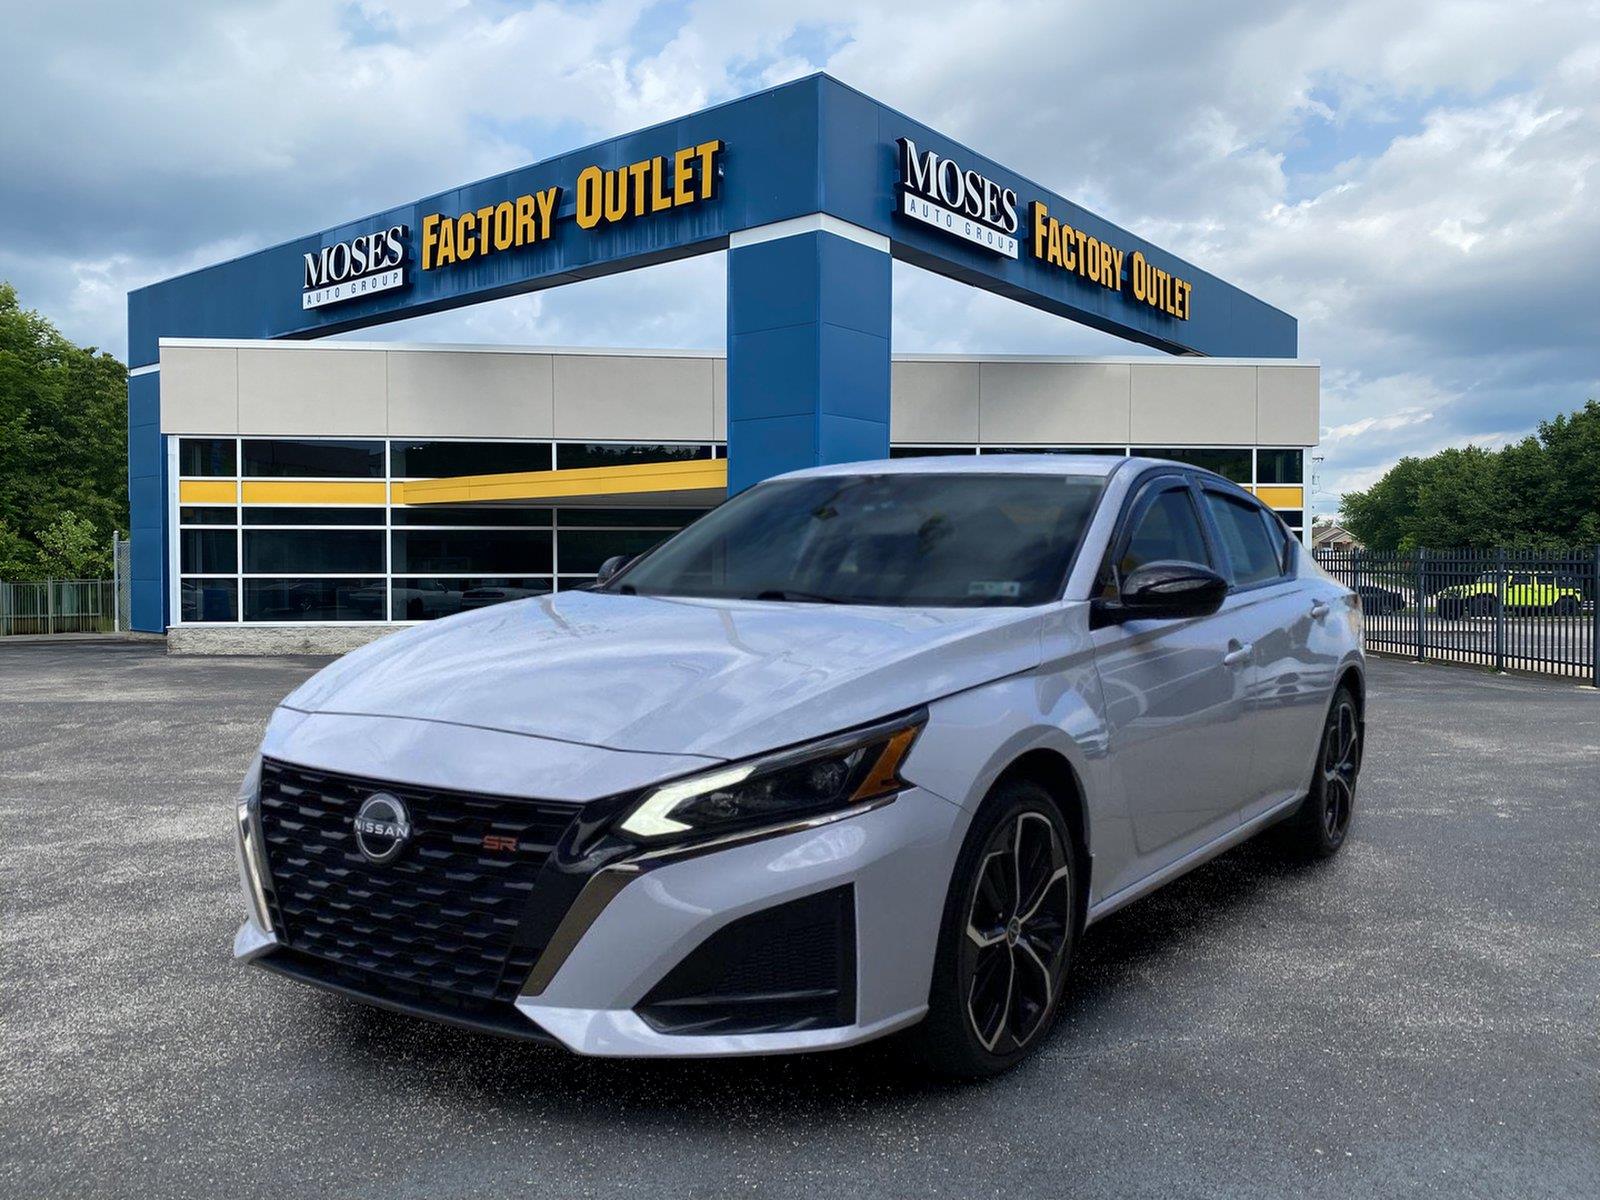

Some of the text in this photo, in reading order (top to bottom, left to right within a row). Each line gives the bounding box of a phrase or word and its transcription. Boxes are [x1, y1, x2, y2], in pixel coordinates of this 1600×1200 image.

[422, 140, 721, 270] FACTORY OUTLET
[903, 137, 1019, 234] MOSES
[909, 198, 1015, 253] AUTO GROUP
[302, 226, 405, 288] MOSES
[1034, 200, 1193, 321] FACTORY OUTLET
[306, 271, 400, 306] AUTO GROUP
[353, 820, 410, 839] NISSAN
[482, 835, 519, 852] SR
